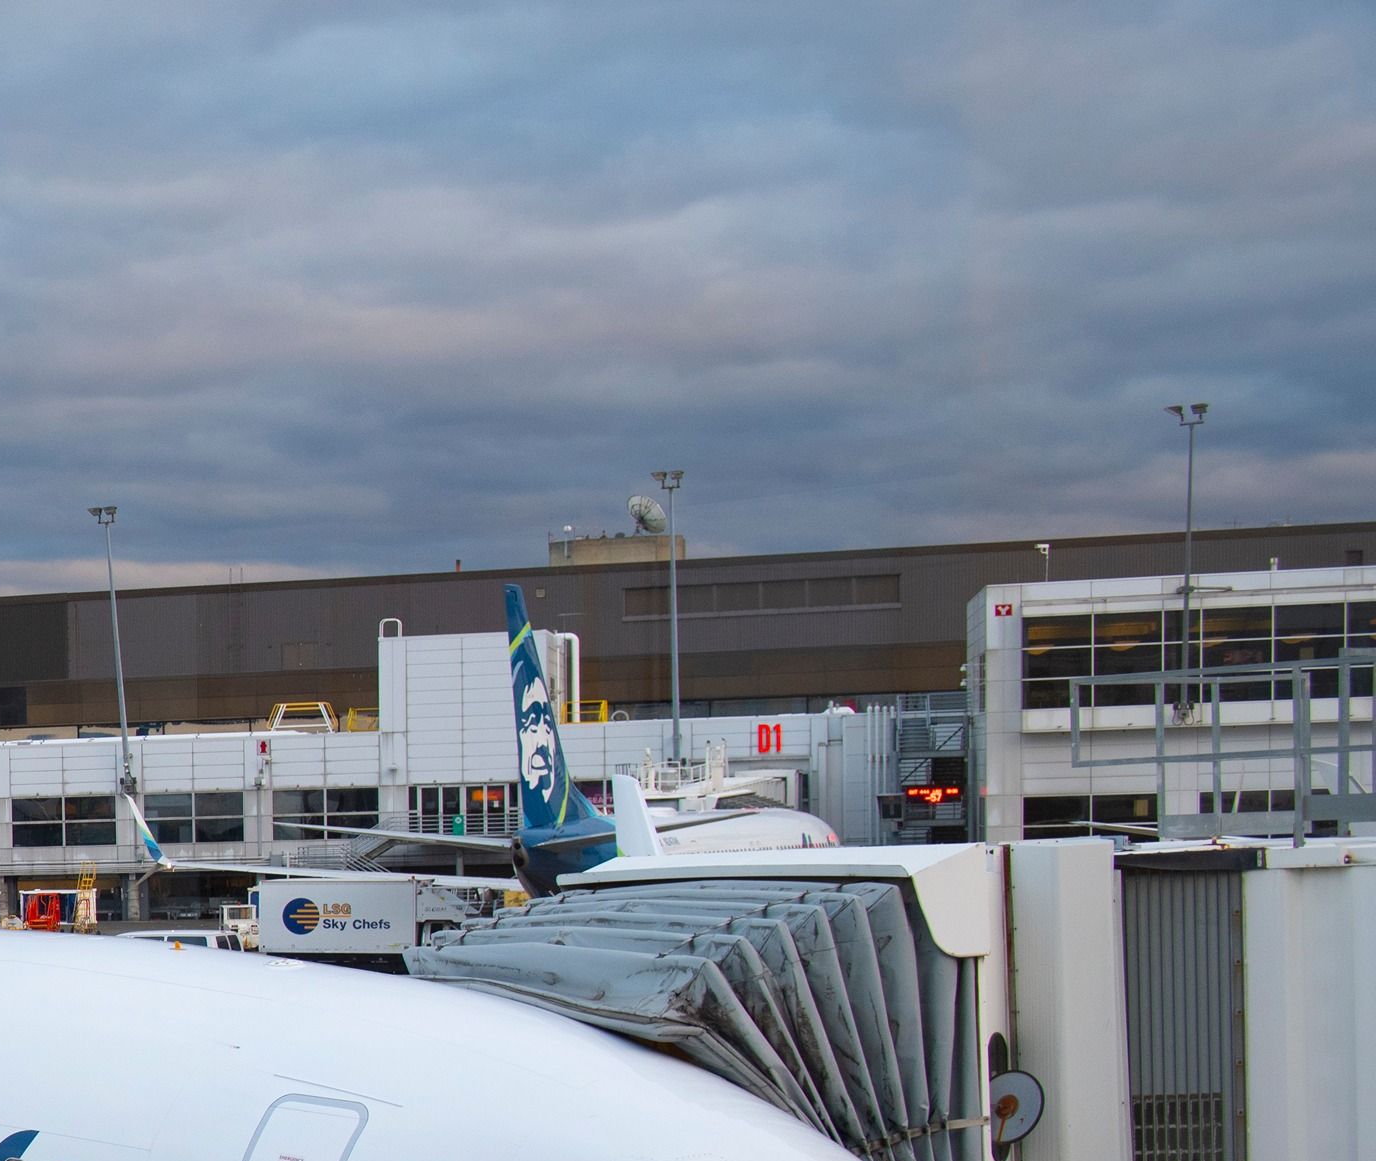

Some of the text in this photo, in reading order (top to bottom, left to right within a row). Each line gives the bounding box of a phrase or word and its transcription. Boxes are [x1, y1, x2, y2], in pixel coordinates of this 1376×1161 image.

[758, 724, 782, 753] D1
[323, 903, 352, 915] LSG
[322, 918, 391, 931] Sky Chefs
